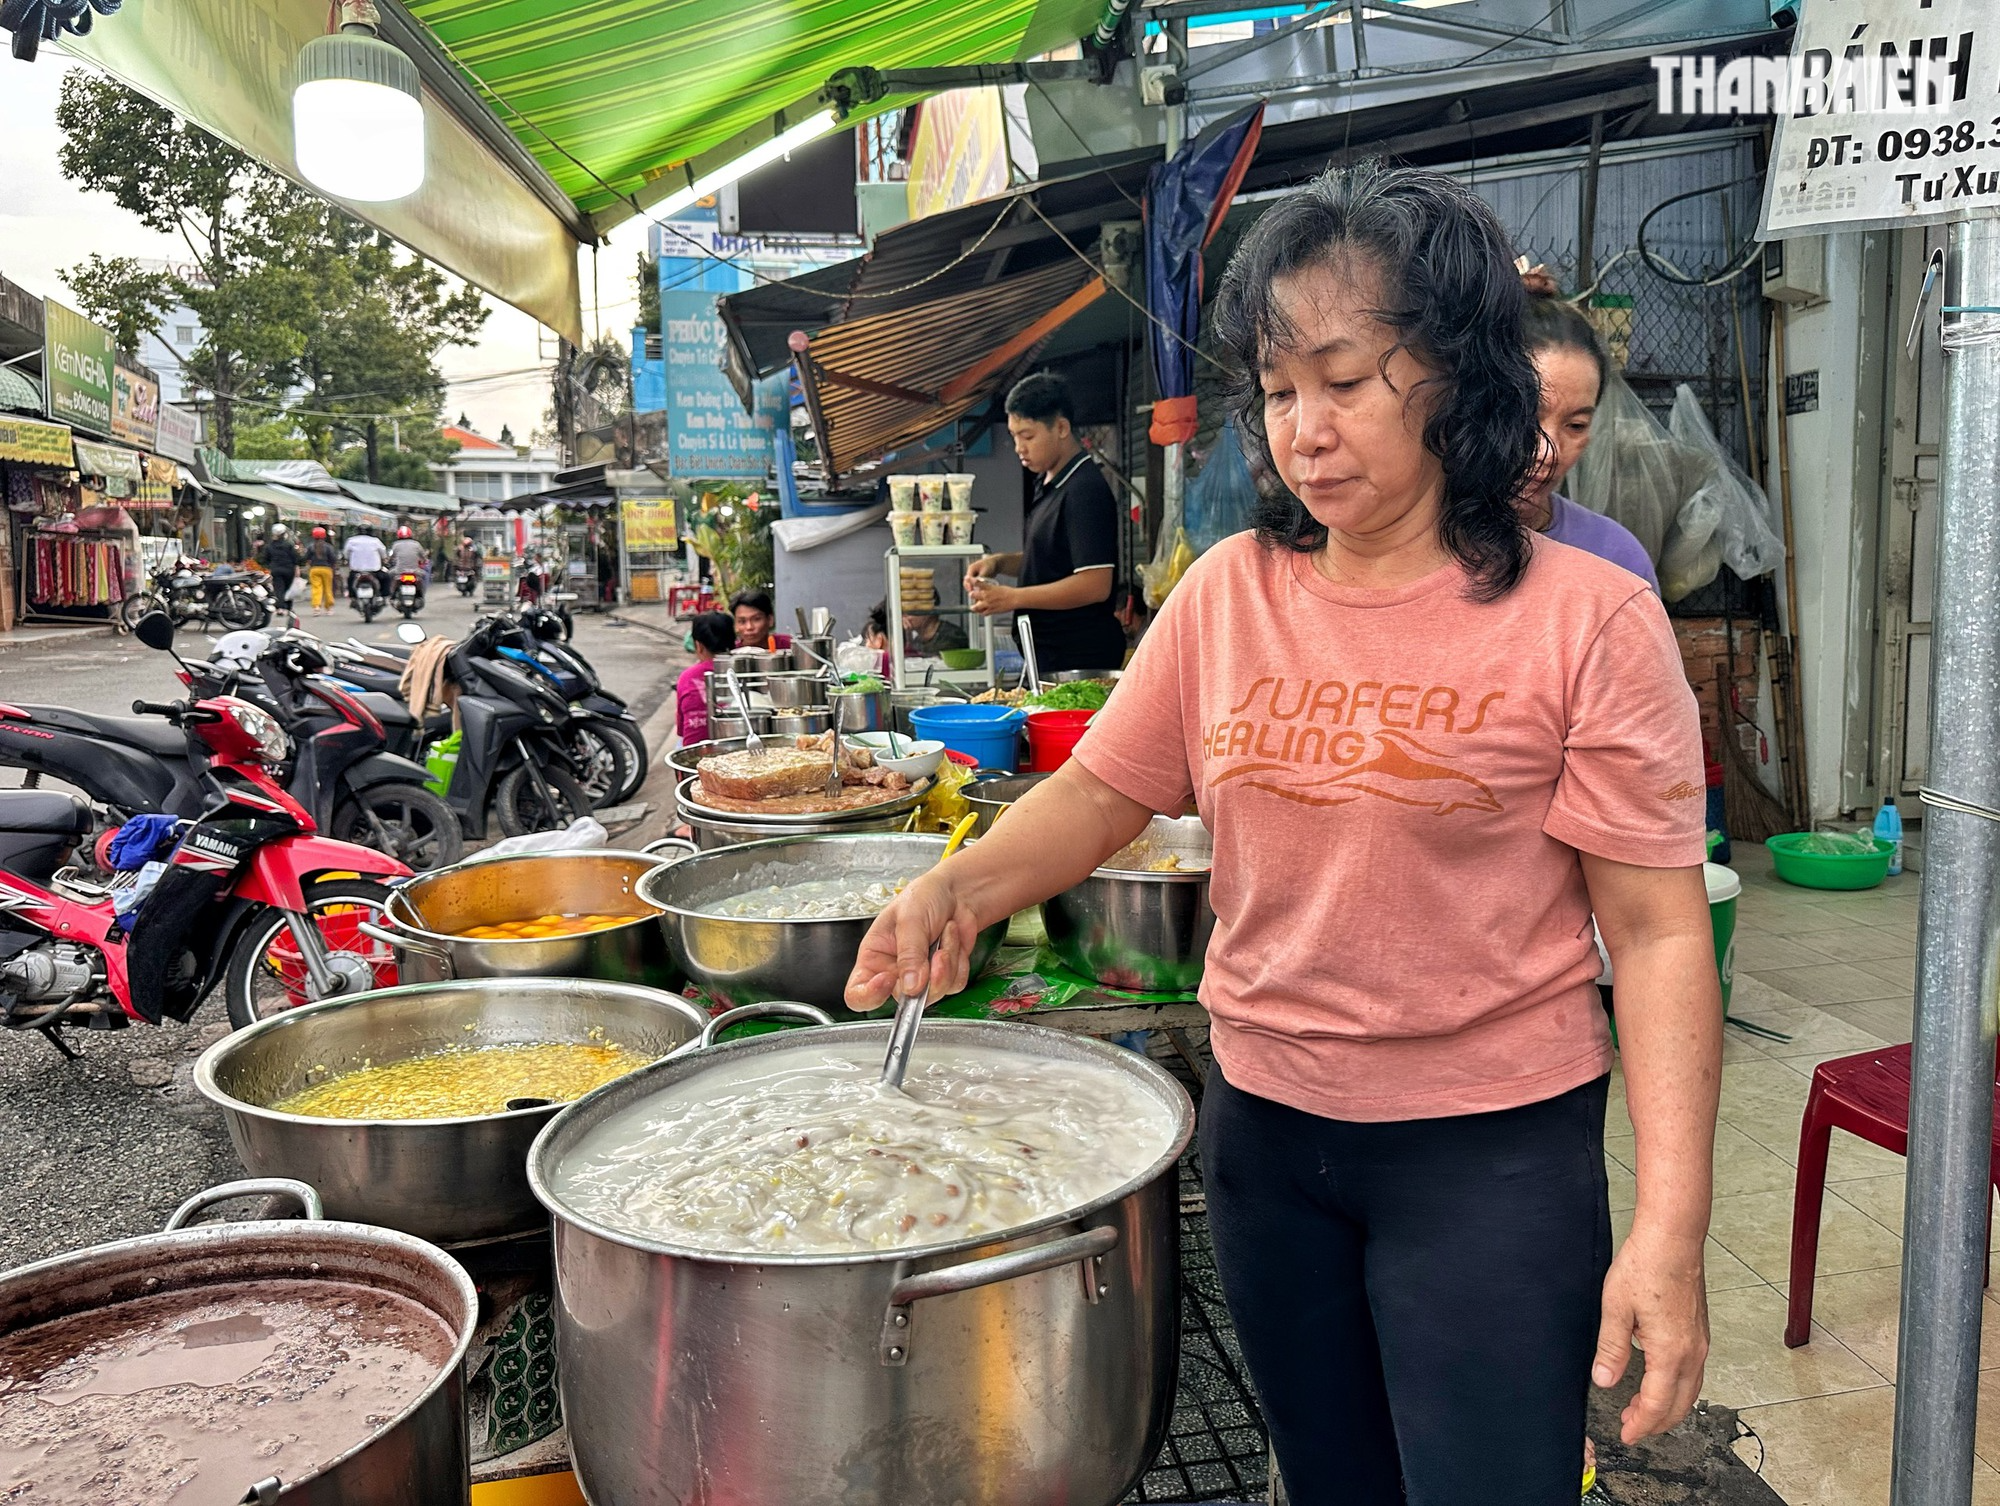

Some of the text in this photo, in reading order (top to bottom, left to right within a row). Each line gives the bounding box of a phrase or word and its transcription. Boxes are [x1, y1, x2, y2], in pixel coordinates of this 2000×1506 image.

[1807, 135, 1863, 169] ĐT:
[668, 312, 712, 344] PHÚC
[1230, 677, 1505, 734] SURFERS
[1203, 720, 1366, 766] HEALING
[195, 833, 239, 858] YAMAHA
